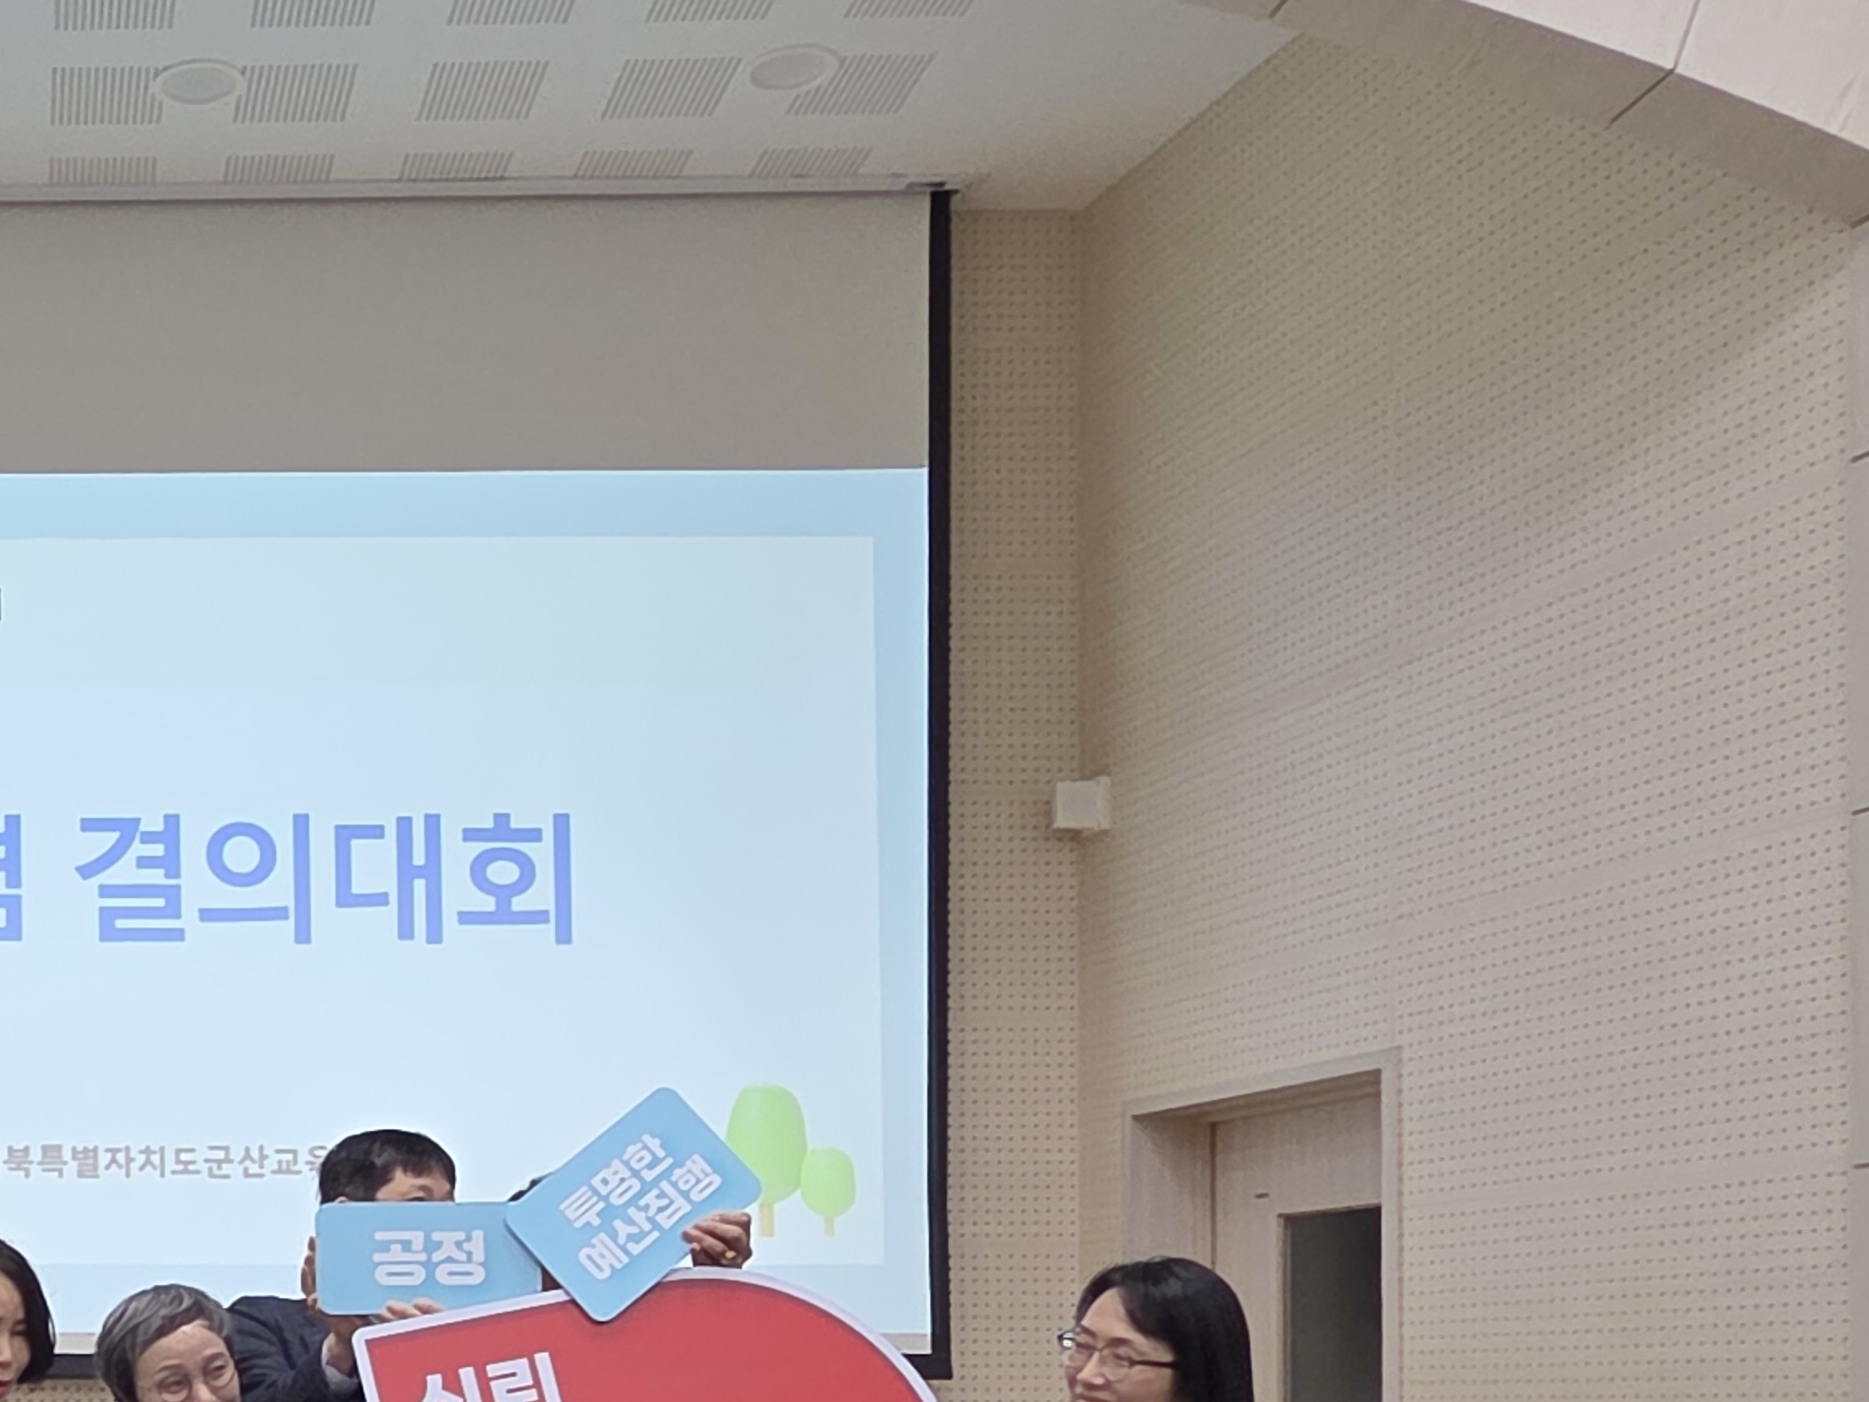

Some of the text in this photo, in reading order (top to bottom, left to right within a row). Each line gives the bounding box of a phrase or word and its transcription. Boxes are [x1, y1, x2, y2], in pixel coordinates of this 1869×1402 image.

[74, 812, 573, 945] 결의대회
[559, 1133, 674, 1230] 투명한
[577, 1152, 723, 1281] 예산집행
[372, 1229, 486, 1287] 공정
